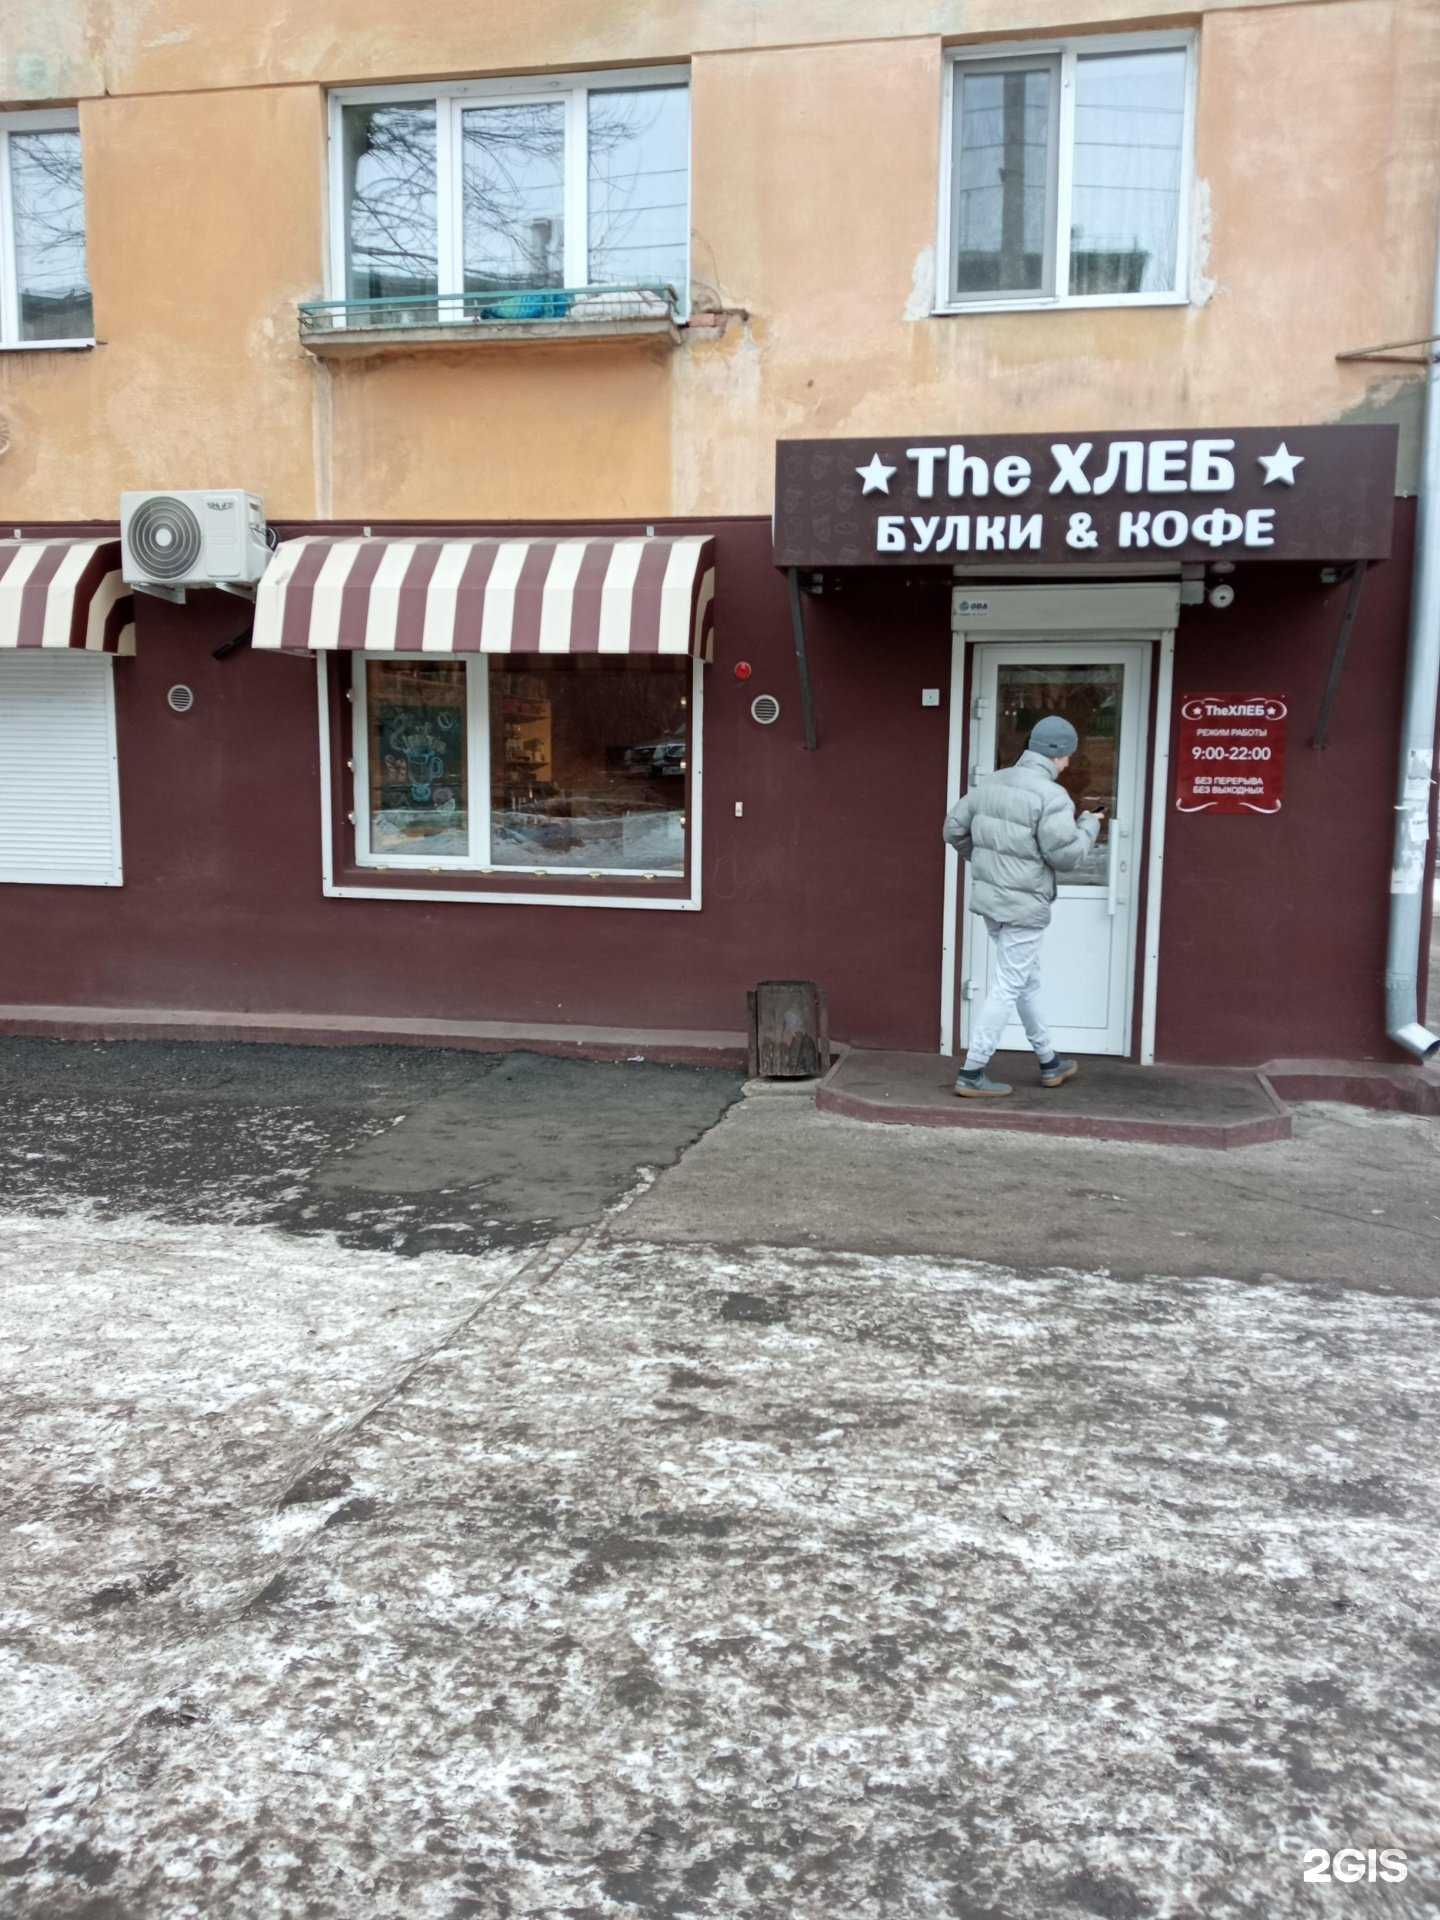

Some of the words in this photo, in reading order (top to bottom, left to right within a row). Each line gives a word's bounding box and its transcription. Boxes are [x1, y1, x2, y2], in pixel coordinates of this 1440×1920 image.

[906, 445, 1031, 497] The
[1049, 439, 1235, 494] ХЛЕБ
[876, 514, 1043, 551] БУЛКИ
[1065, 512, 1098, 548] &
[1118, 508, 1276, 548] КОФЕ
[1196, 728, 1230, 737] РЕЖИМ
[1230, 728, 1268, 737] РАБОТЫ
[1192, 746, 1272, 760] 9:00-22:00
[1194, 777, 1212, 785] БЕЗ
[1214, 777, 1264, 785] ПЕРЕРЫВА
[1192, 786, 1211, 794] БЕЗ
[1211, 786, 1264, 795] ВЫХОДНЫХ
